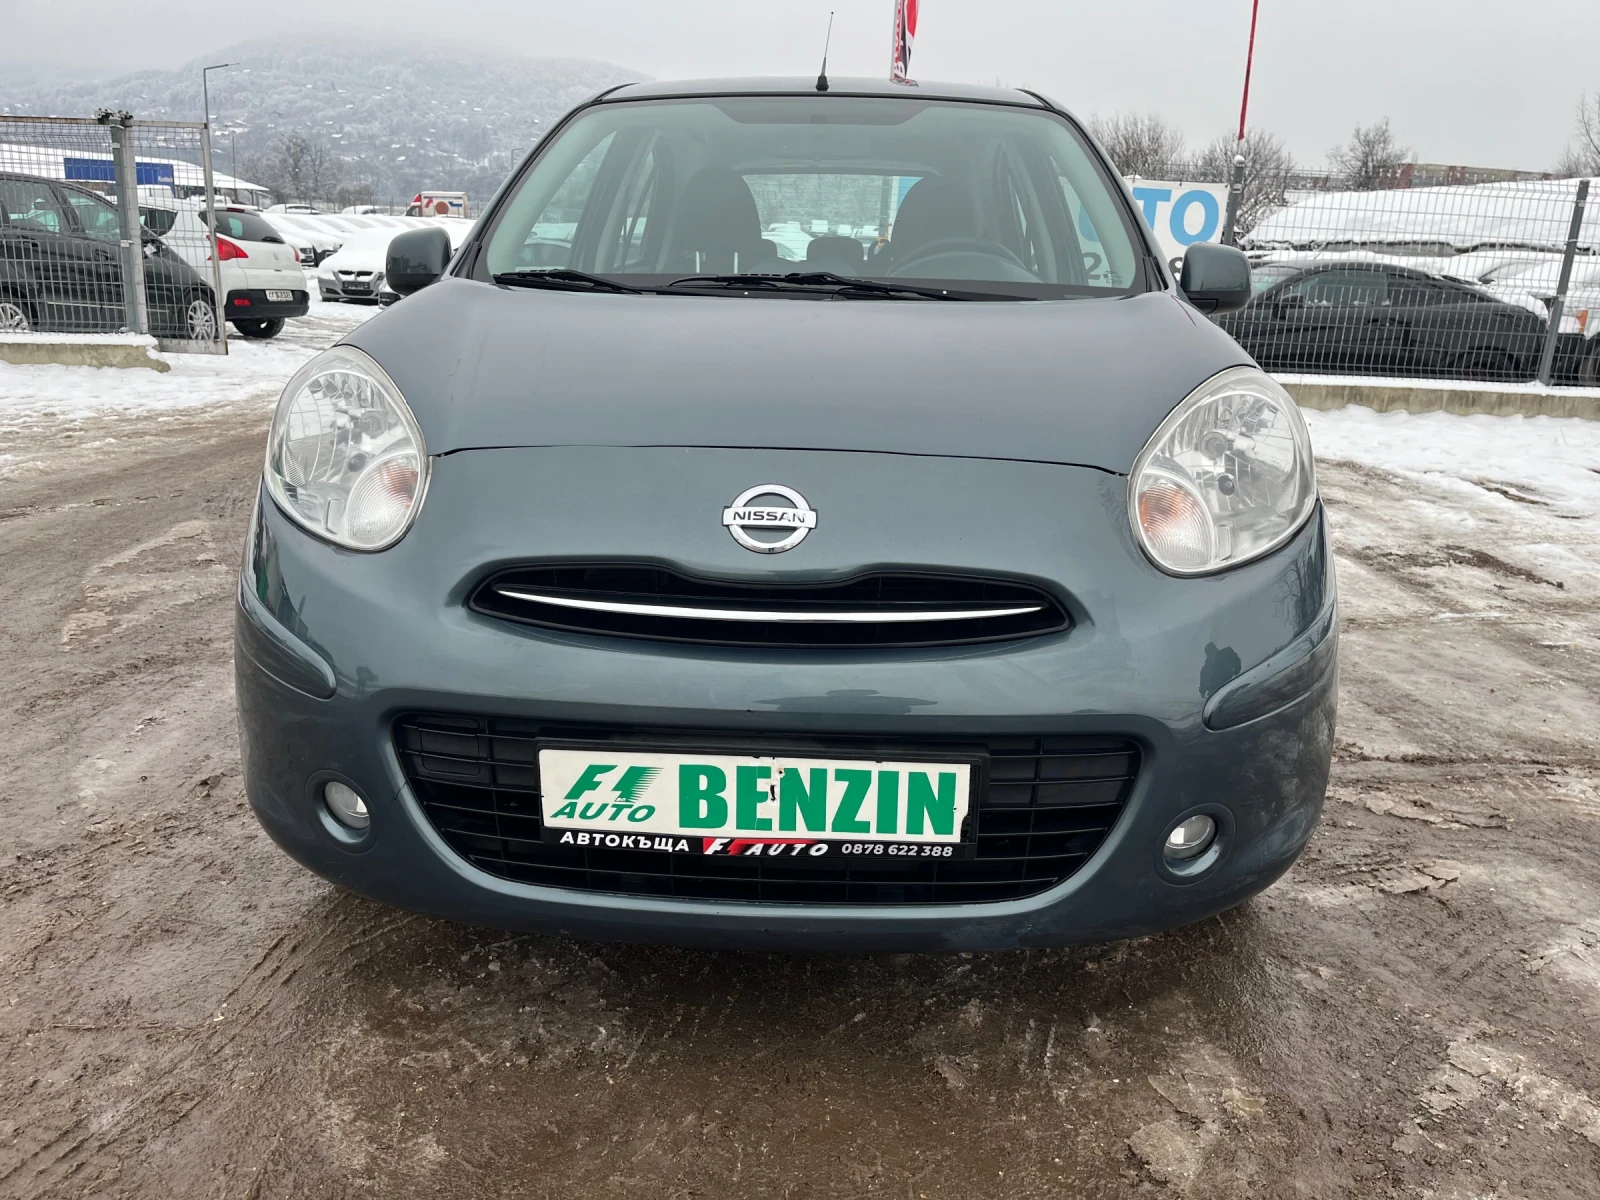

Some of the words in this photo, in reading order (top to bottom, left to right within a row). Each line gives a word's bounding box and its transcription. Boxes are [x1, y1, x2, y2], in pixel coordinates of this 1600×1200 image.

[733, 510, 806, 523] NISSAN
[679, 764, 957, 835] BENZIN
[550, 801, 656, 822] AUTO
[559, 831, 690, 853] АВТОКЪЩА
[743, 843, 829, 856] AUTO
[841, 843, 884, 855] 0878
[888, 844, 918, 856] 622
[920, 846, 953, 857] 388
